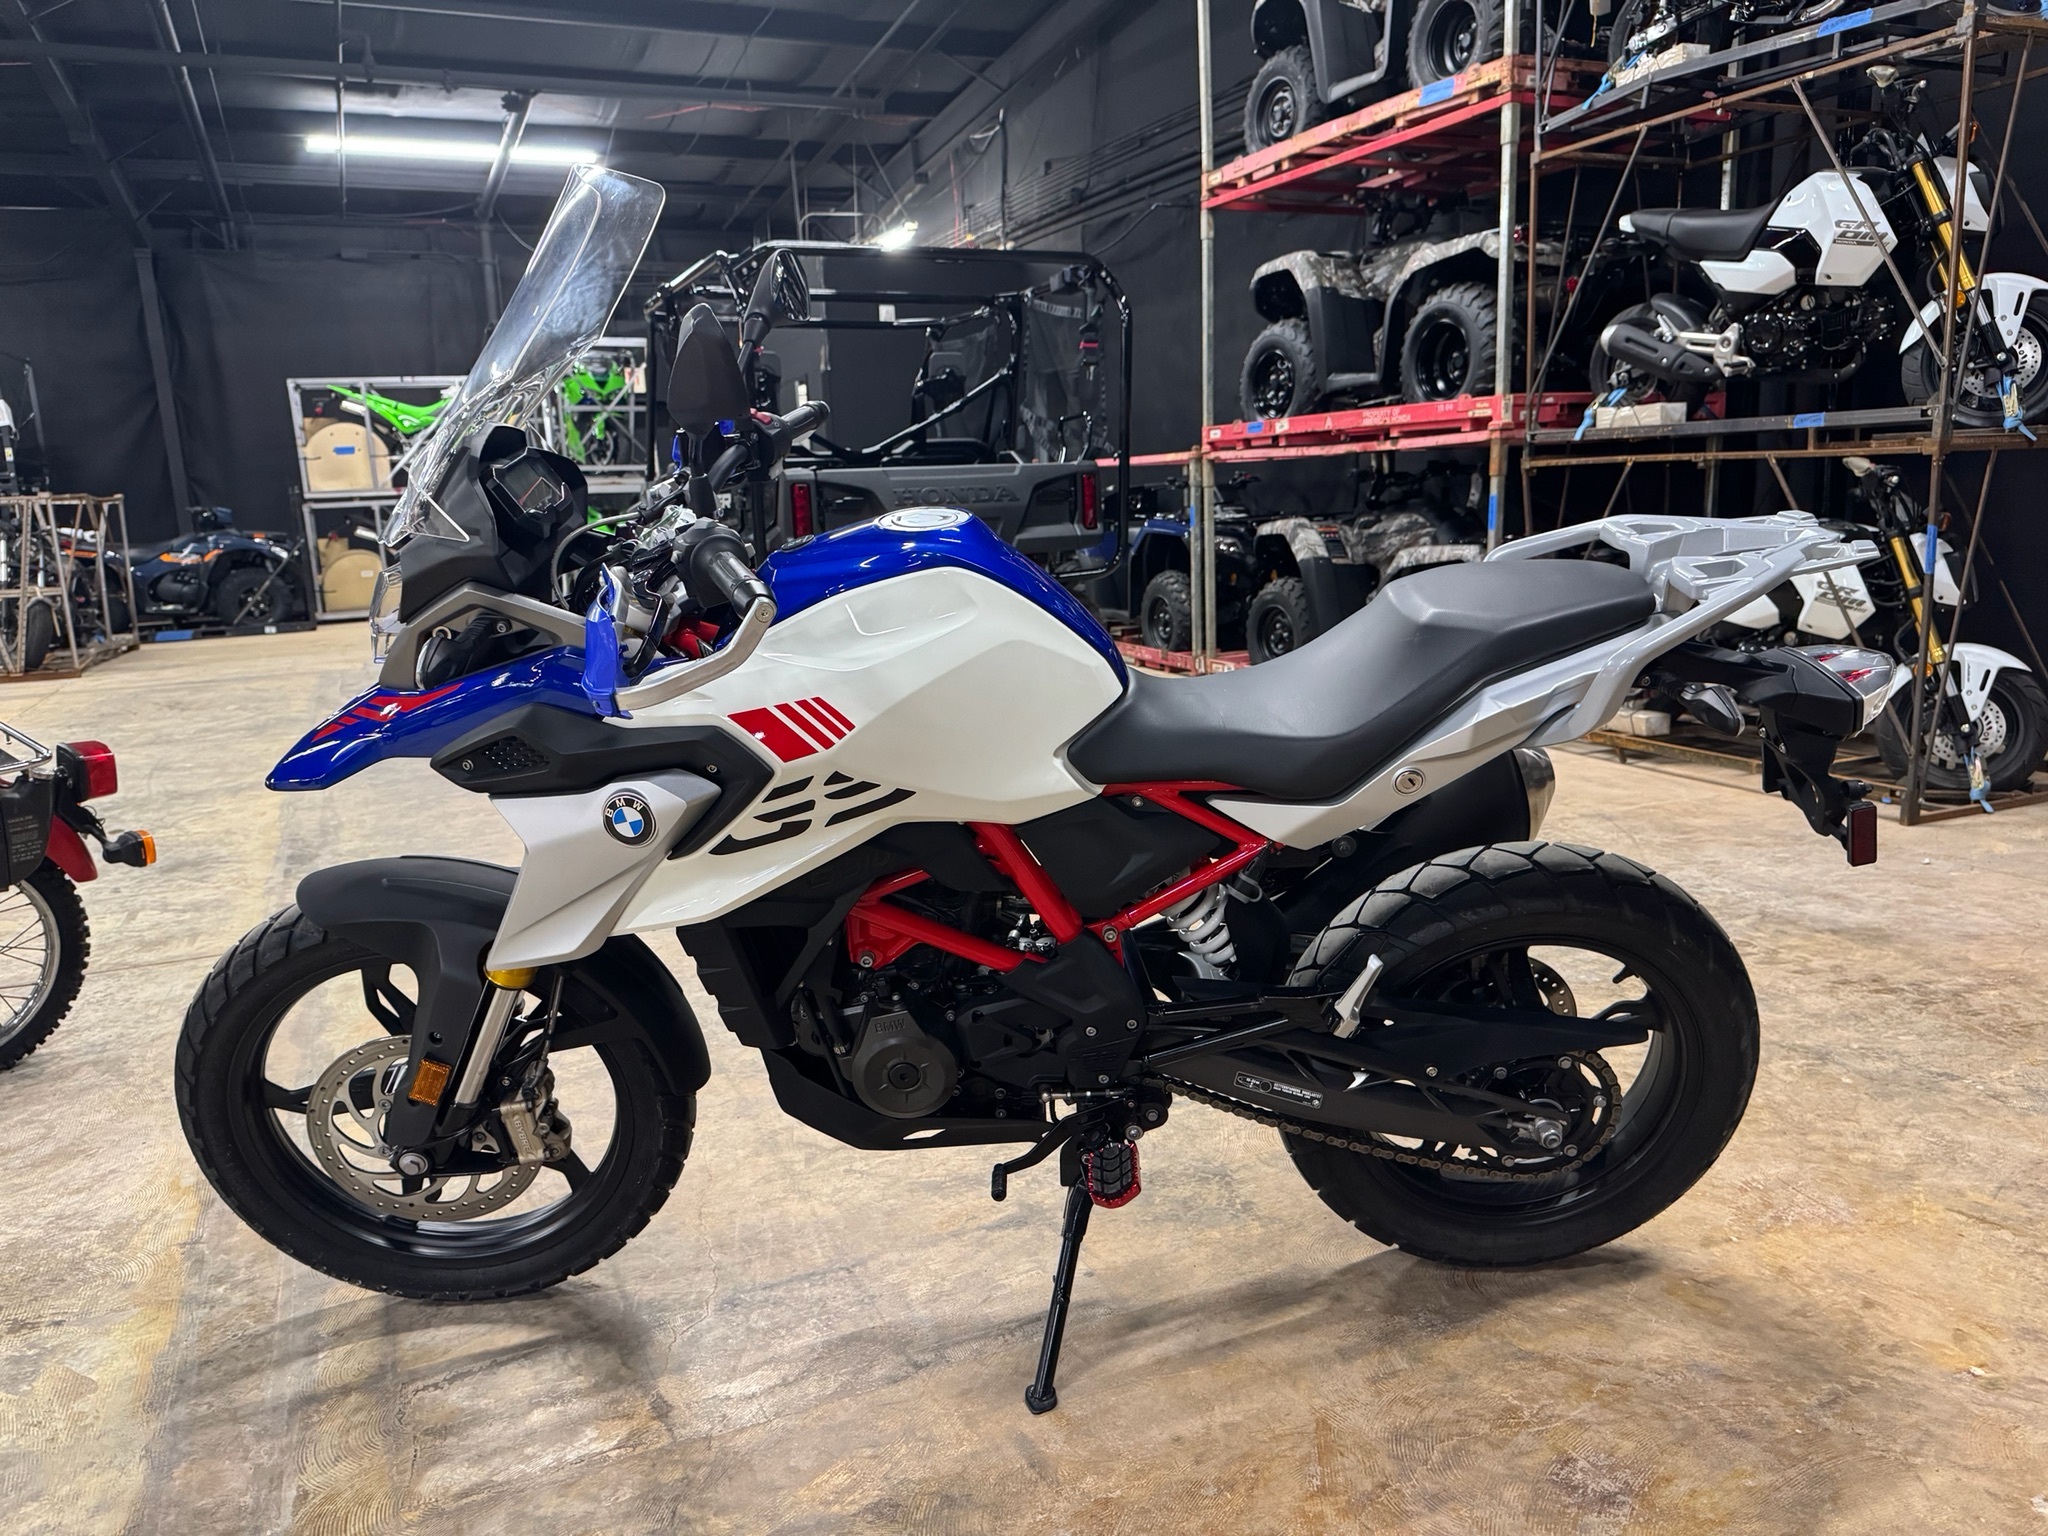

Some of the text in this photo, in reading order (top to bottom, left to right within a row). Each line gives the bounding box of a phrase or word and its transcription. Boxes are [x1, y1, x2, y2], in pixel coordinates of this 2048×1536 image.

[893, 485, 1020, 505] HONDA
[605, 797, 644, 818] BMW
[874, 1018, 905, 1034] BMW
